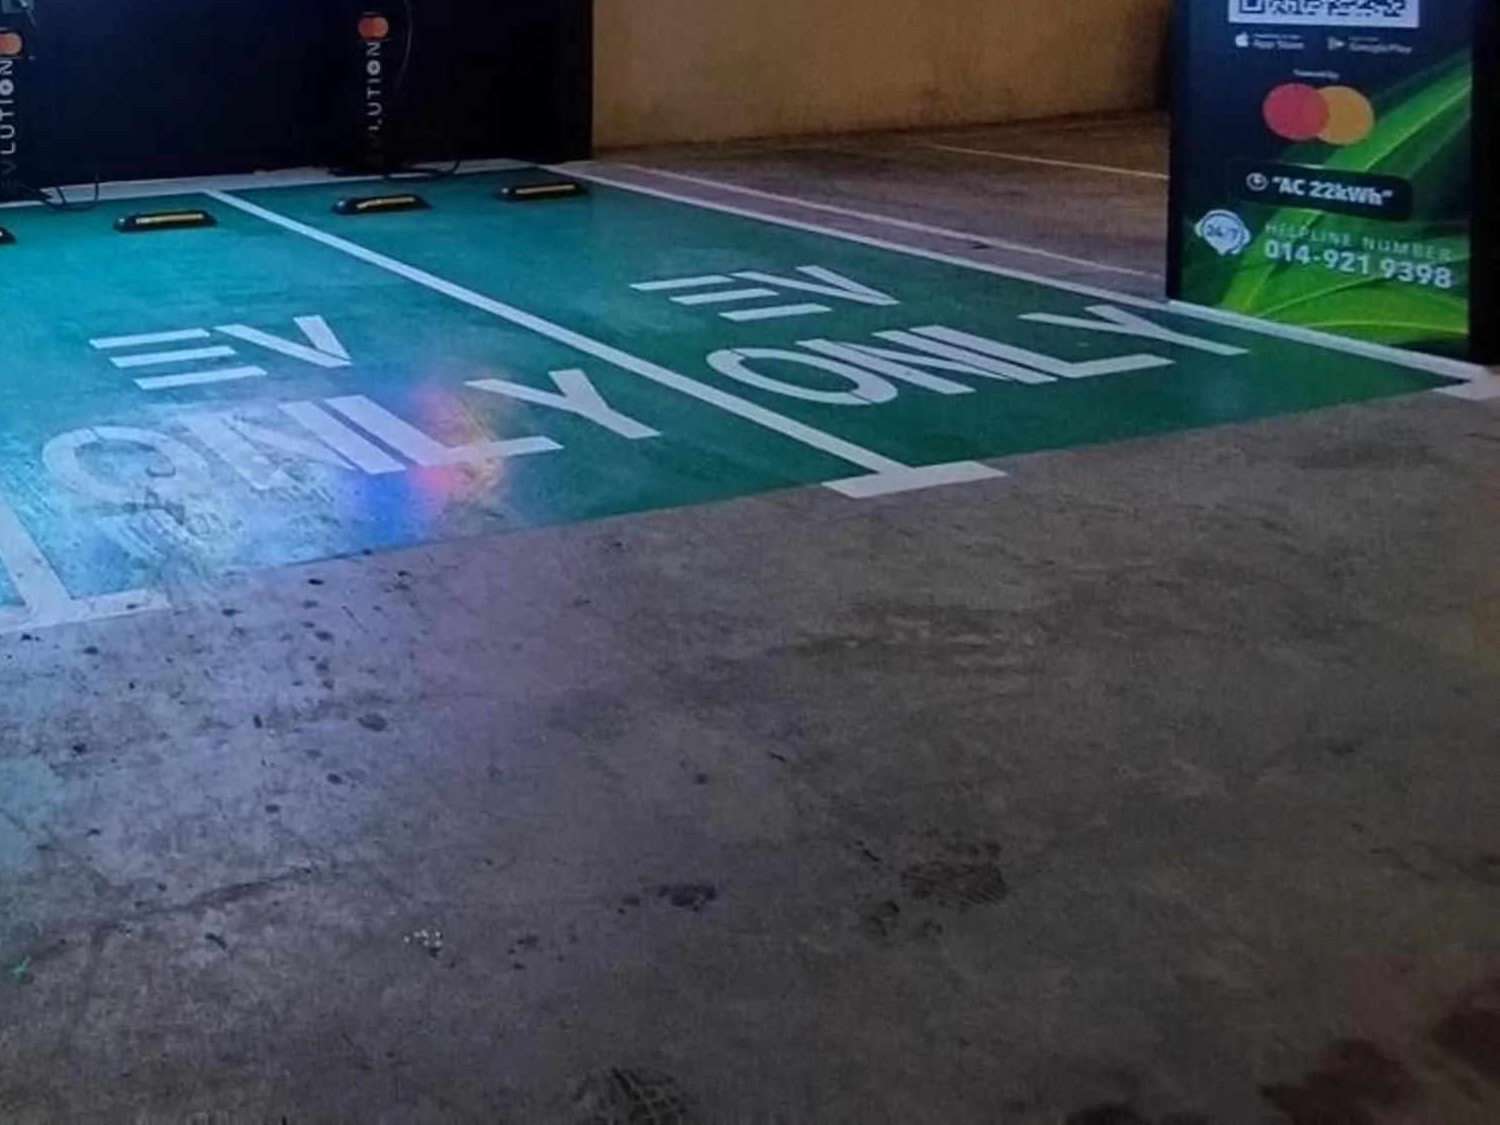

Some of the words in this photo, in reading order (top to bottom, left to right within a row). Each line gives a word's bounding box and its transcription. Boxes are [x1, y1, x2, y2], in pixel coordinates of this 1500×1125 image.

[1264, 240, 1371, 274] 014-921
[1380, 258, 1453, 289] 9398
[1362, 236, 1453, 262] NUMBER
[630, 264, 901, 324] EV
[89, 314, 353, 391] EV
[706, 304, 1249, 408] ONLY
[41, 369, 660, 510] ONLY
